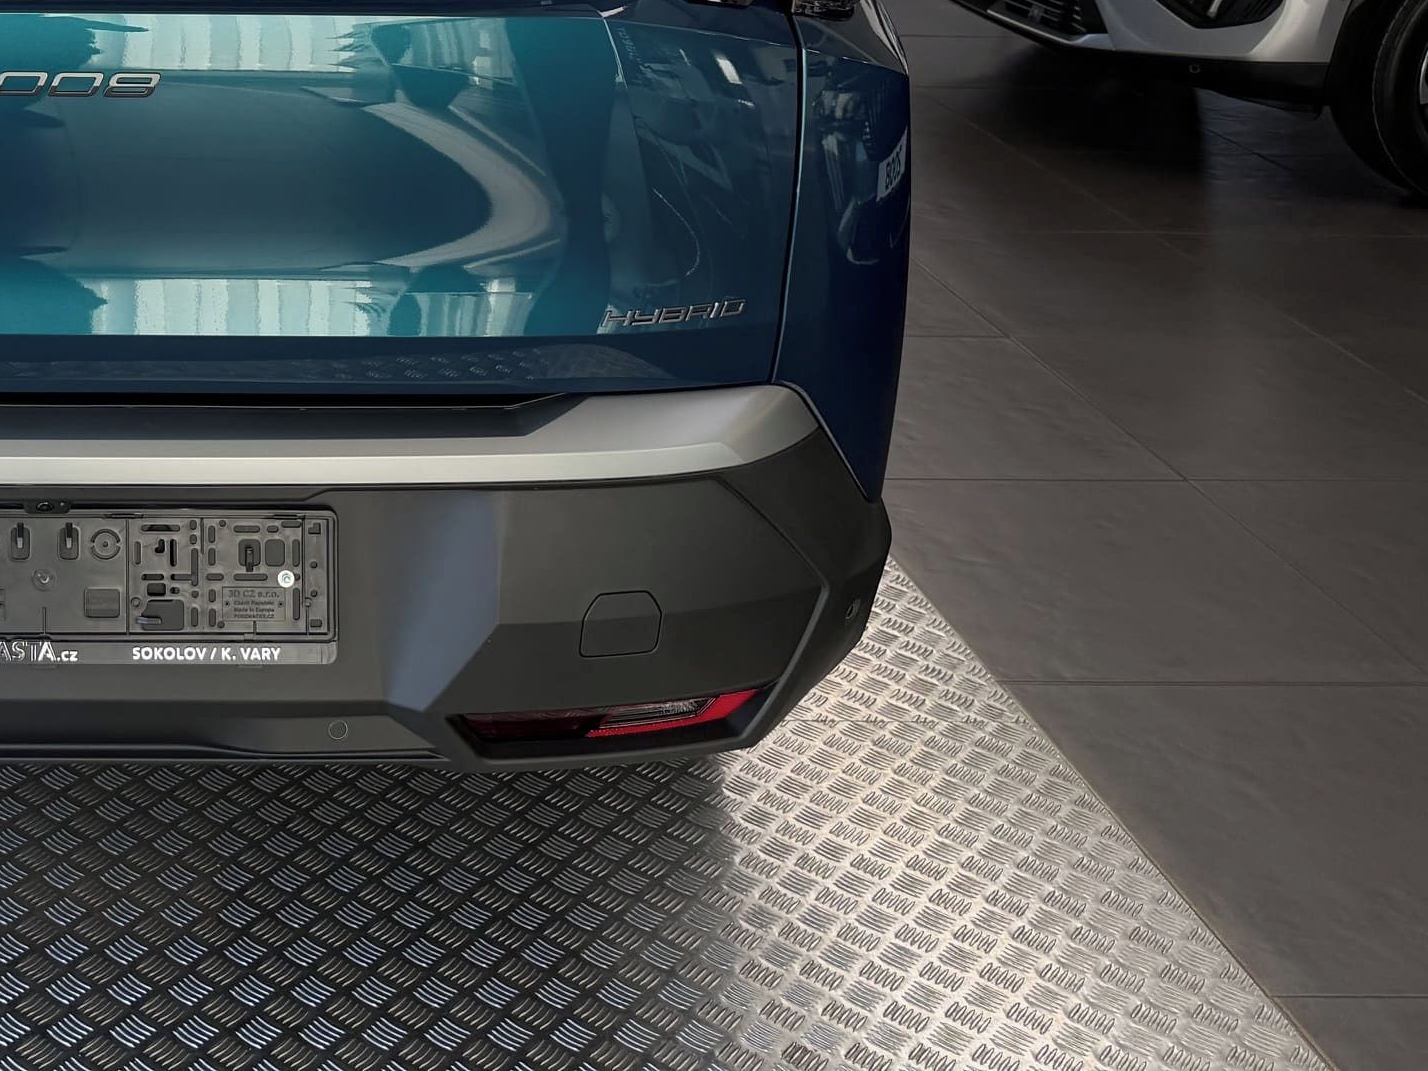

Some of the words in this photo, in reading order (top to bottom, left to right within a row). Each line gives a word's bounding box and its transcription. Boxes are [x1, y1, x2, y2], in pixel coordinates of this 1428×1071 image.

[601, 298, 746, 327] HYBRID
[132, 646, 207, 661] SOKOLOV
[210, 647, 217, 661] /
[222, 647, 237, 661] K.
[240, 647, 281, 661] VARY
